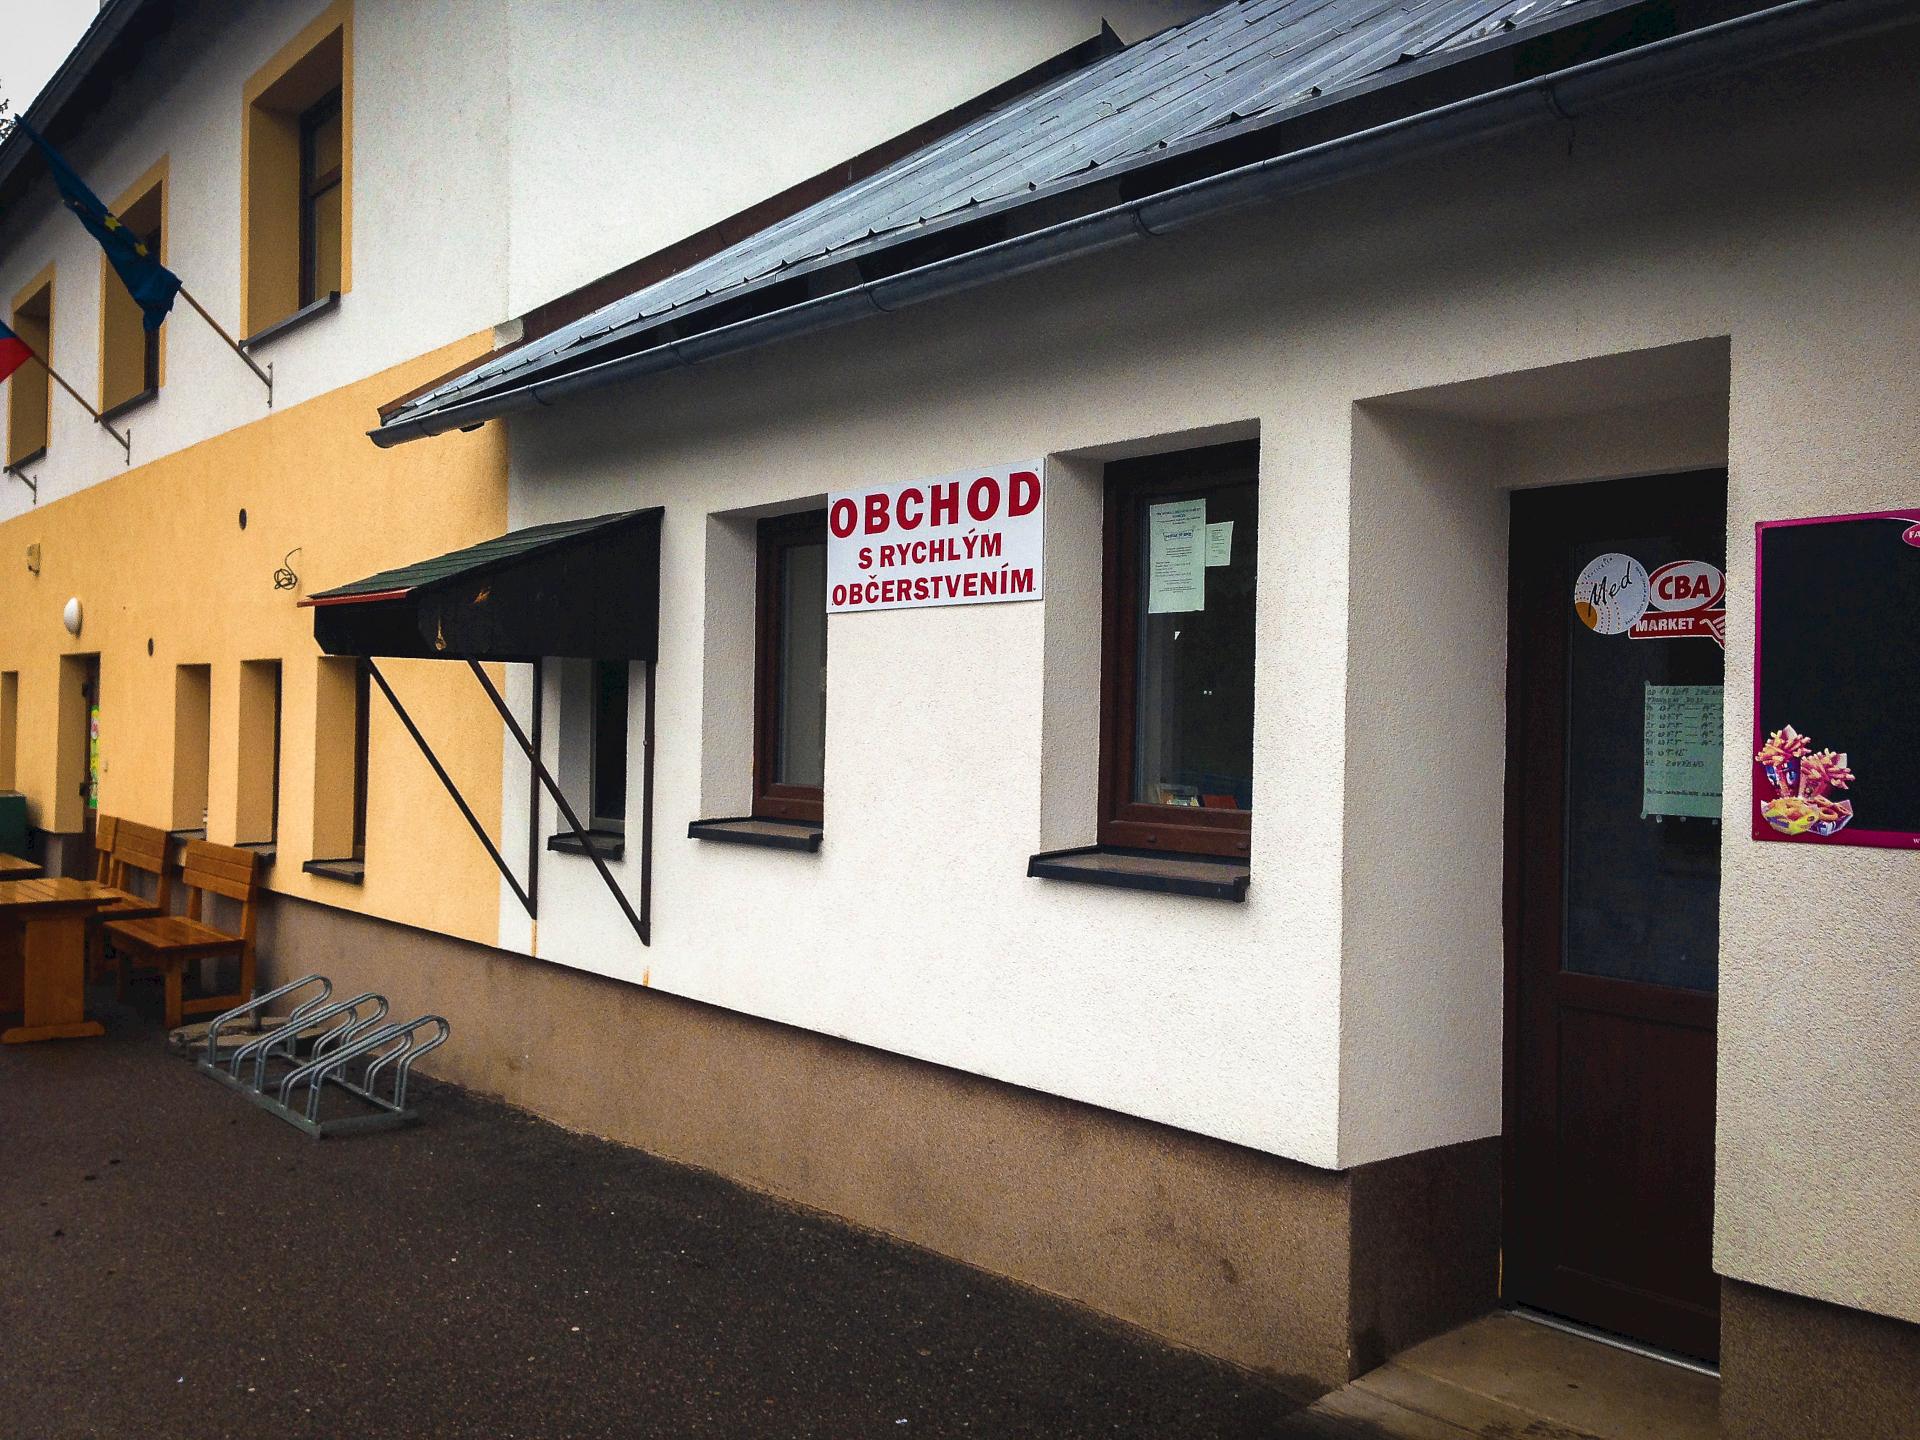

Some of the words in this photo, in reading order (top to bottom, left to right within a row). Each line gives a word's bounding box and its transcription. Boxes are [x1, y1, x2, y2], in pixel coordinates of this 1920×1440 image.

[829, 471, 1041, 538] OBCHOD
[858, 547, 873, 569] S
[879, 528, 1002, 568] RYCHLÝM
[832, 562, 1034, 606] OBČERSTVENÍM
[1588, 561, 1633, 618] Med
[1658, 575, 1712, 601] CBA
[1635, 617, 1696, 632] MARKET
